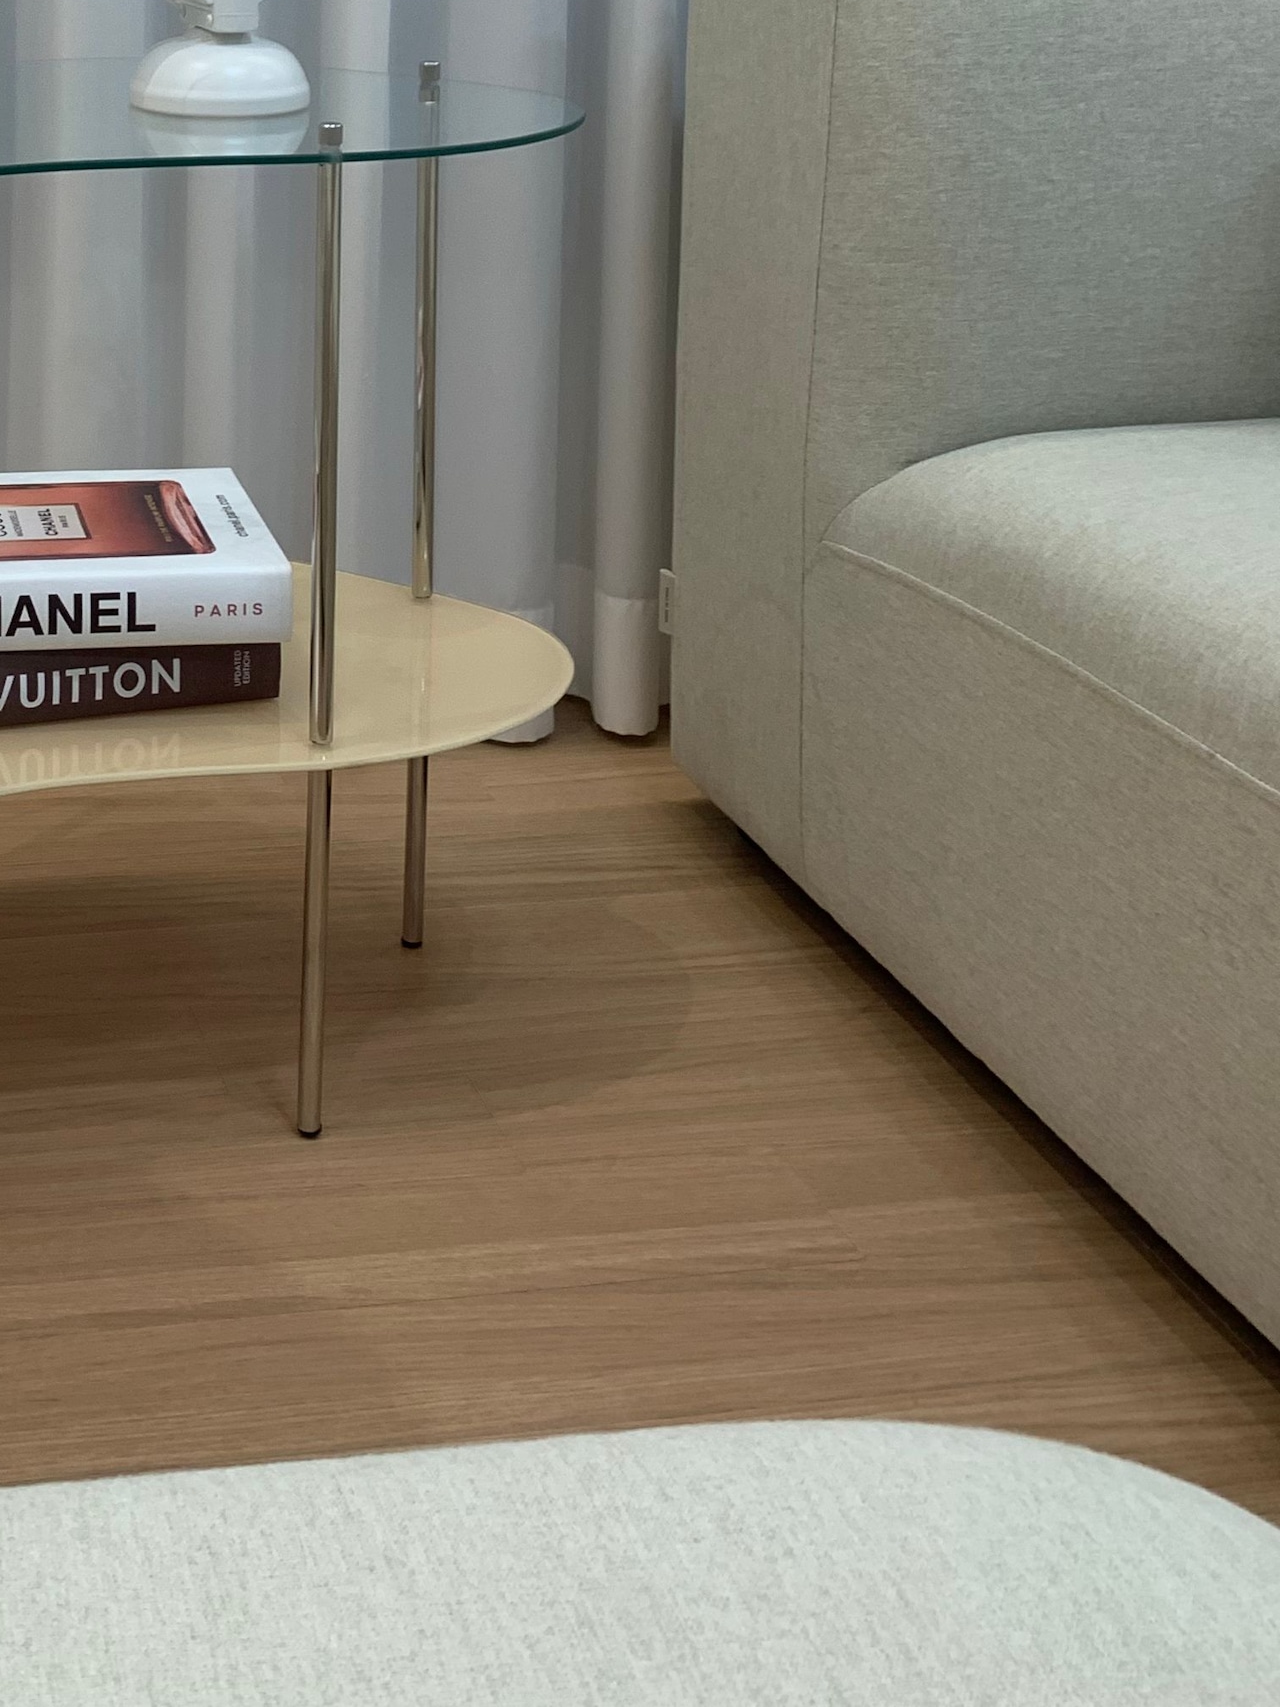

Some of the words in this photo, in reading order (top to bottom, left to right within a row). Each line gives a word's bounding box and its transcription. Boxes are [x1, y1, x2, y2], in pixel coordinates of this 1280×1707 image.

[194, 603, 264, 617] PARIS
[233, 649, 242, 687] UPDATED
[242, 650, 251, 685] EDITION
